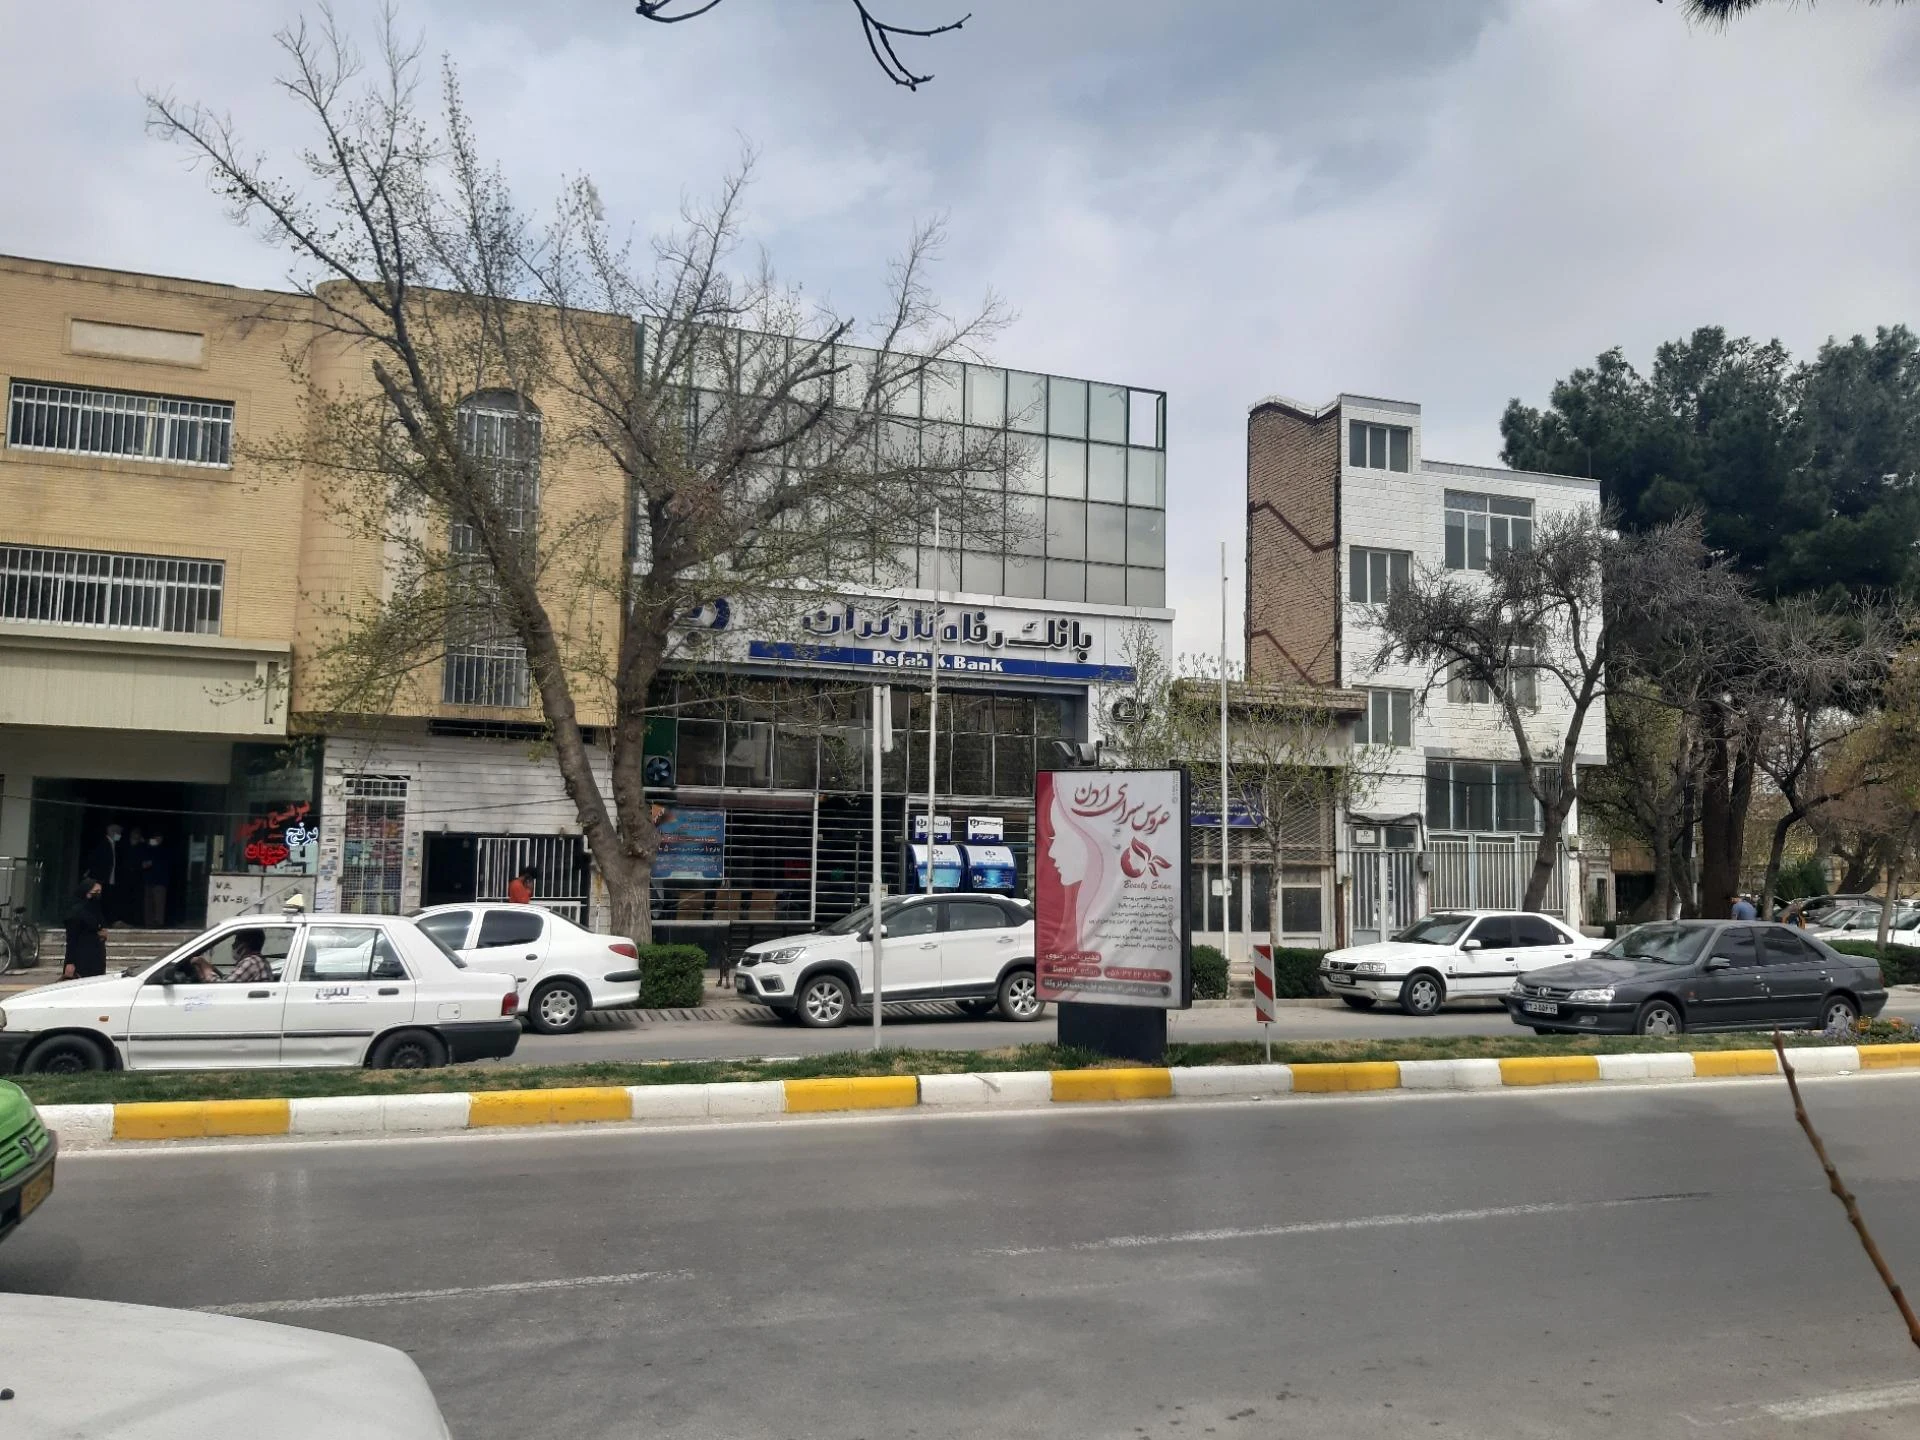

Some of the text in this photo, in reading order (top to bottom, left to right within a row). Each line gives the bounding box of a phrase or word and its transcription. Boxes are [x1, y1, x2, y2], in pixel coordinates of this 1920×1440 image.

[942, 610, 1005, 650] رفاه
[1006, 617, 1093, 663] بانک
[872, 650, 929, 668] Refah
[953, 655, 1004, 672] Bank
[285, 822, 319, 846] برنج
